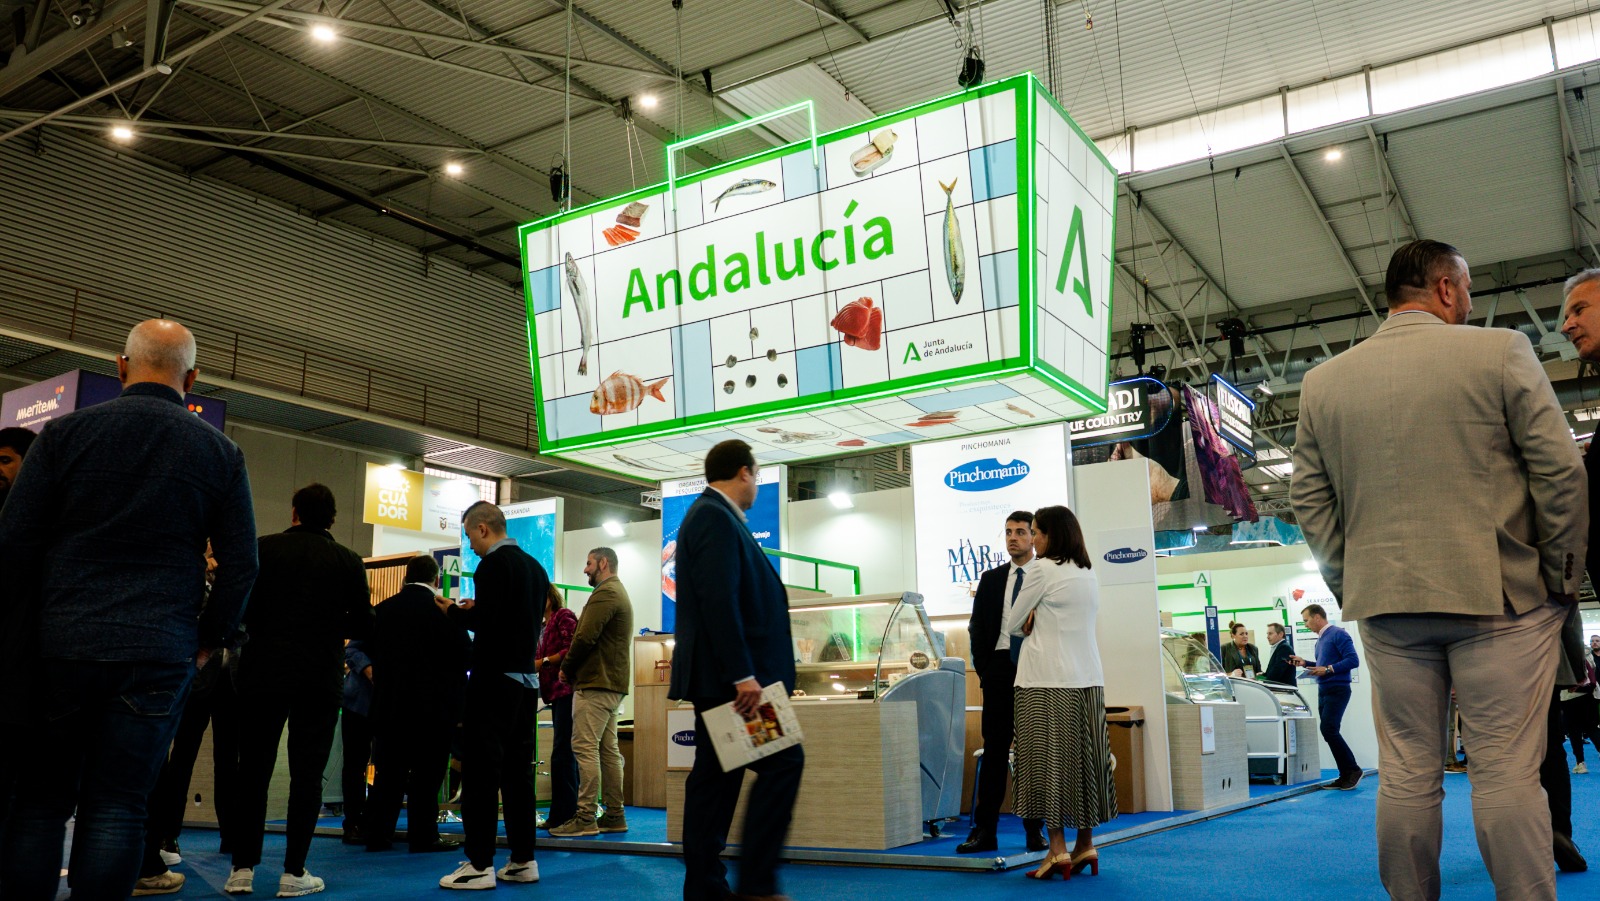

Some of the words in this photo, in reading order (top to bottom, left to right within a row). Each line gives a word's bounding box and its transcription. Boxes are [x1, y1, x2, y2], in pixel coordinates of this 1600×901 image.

[622, 199, 894, 319] Andalucía
[923, 338, 945, 349] Junta
[923, 348, 933, 358] de
[934, 340, 973, 356] Andalucía
[1085, 410, 1143, 430] COUNTRY
[961, 437, 1011, 451] PINCHOMANIA
[949, 463, 1028, 487] Pinchomania
[378, 488, 408, 507] CUA
[378, 503, 408, 521] DOR
[948, 544, 992, 567] MAR
[1106, 550, 1147, 561] Pinchomania
